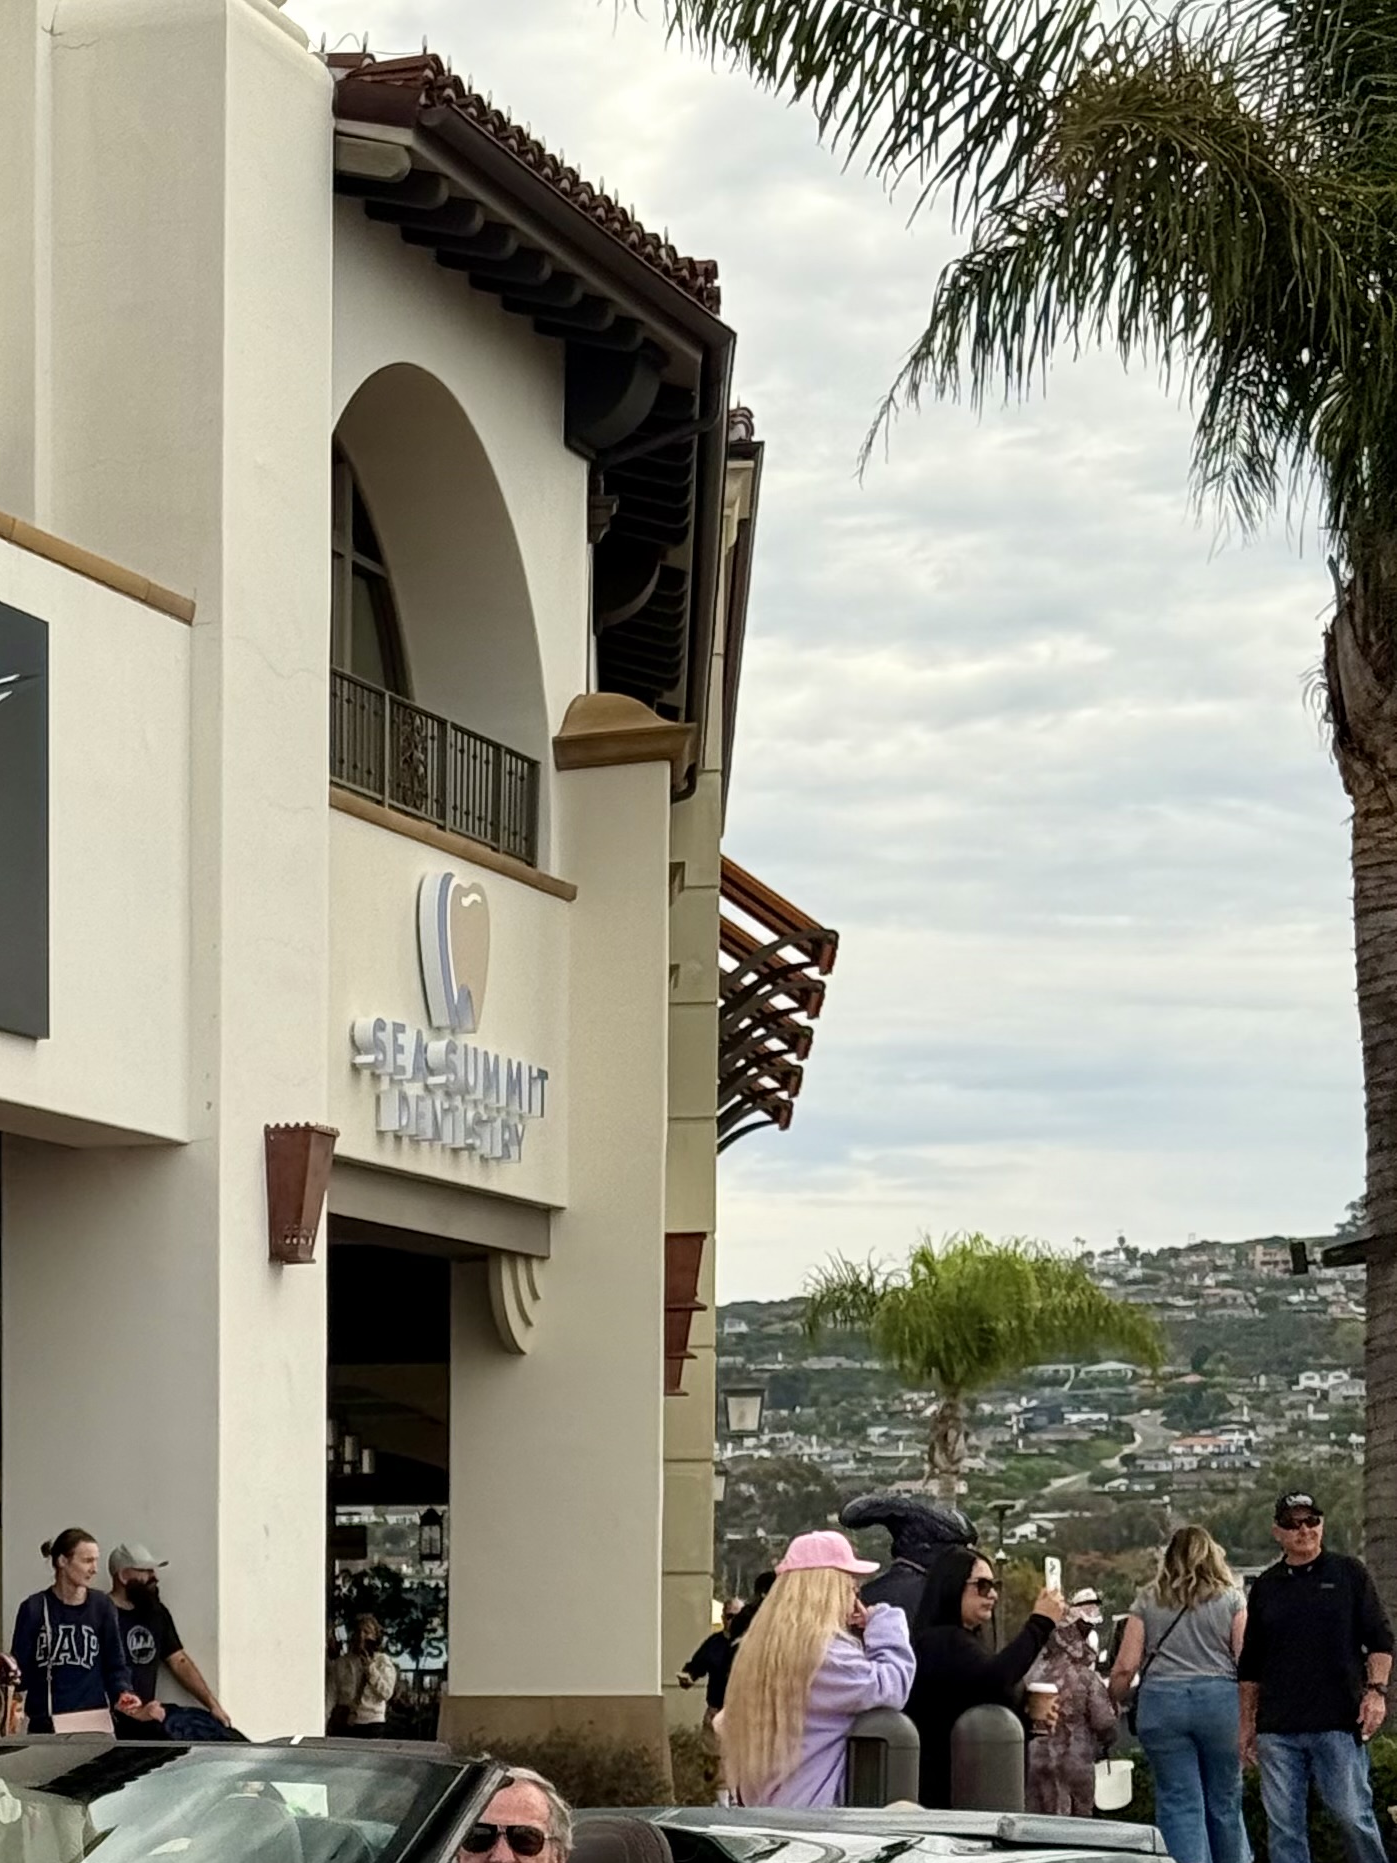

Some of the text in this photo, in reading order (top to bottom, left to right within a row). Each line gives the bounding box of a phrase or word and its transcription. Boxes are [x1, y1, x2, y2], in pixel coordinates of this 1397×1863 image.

[355, 1017, 549, 1119] SEA SUMMIT
[36, 1624, 100, 1670] GAP
